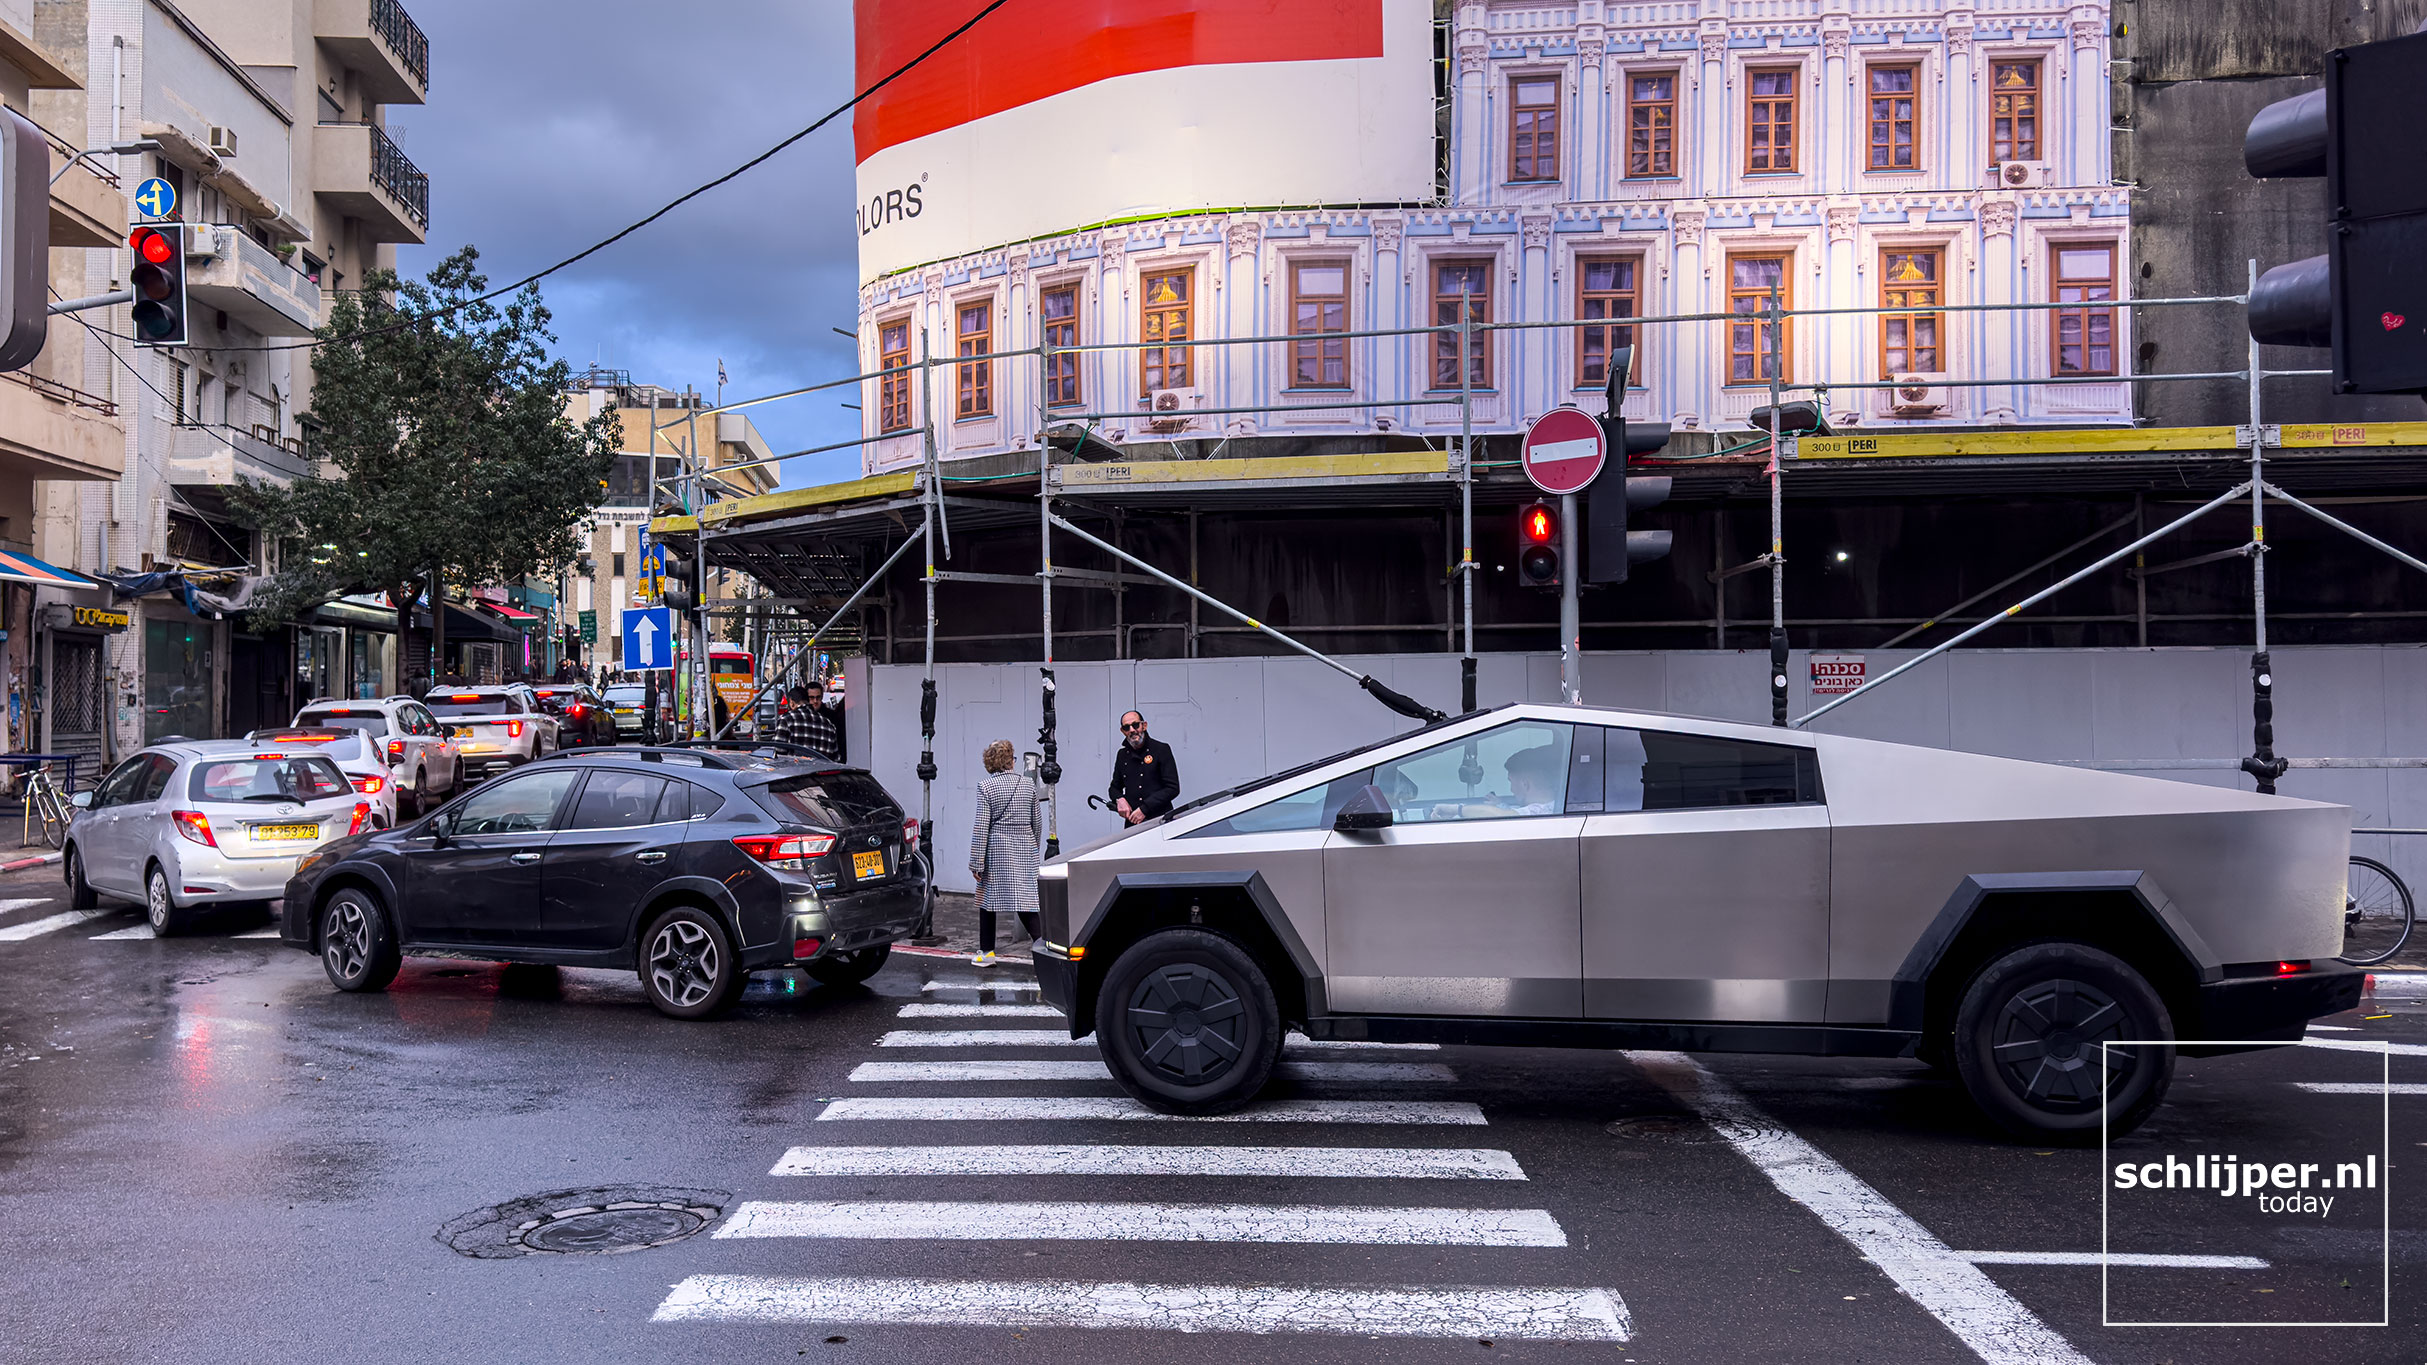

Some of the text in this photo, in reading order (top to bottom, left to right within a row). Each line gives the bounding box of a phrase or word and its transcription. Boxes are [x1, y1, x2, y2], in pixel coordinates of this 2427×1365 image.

[2336, 428, 2366, 441] PERI
[1811, 442, 1832, 452] 300
[1850, 439, 1878, 451] PERI
[1075, 469, 1092, 479] 300
[1109, 466, 1131, 477] PERI
[726, 502, 739, 513] PERI
[1815, 663, 1861, 675] סכנה!
[1814, 678, 1863, 687] כאן בונים
